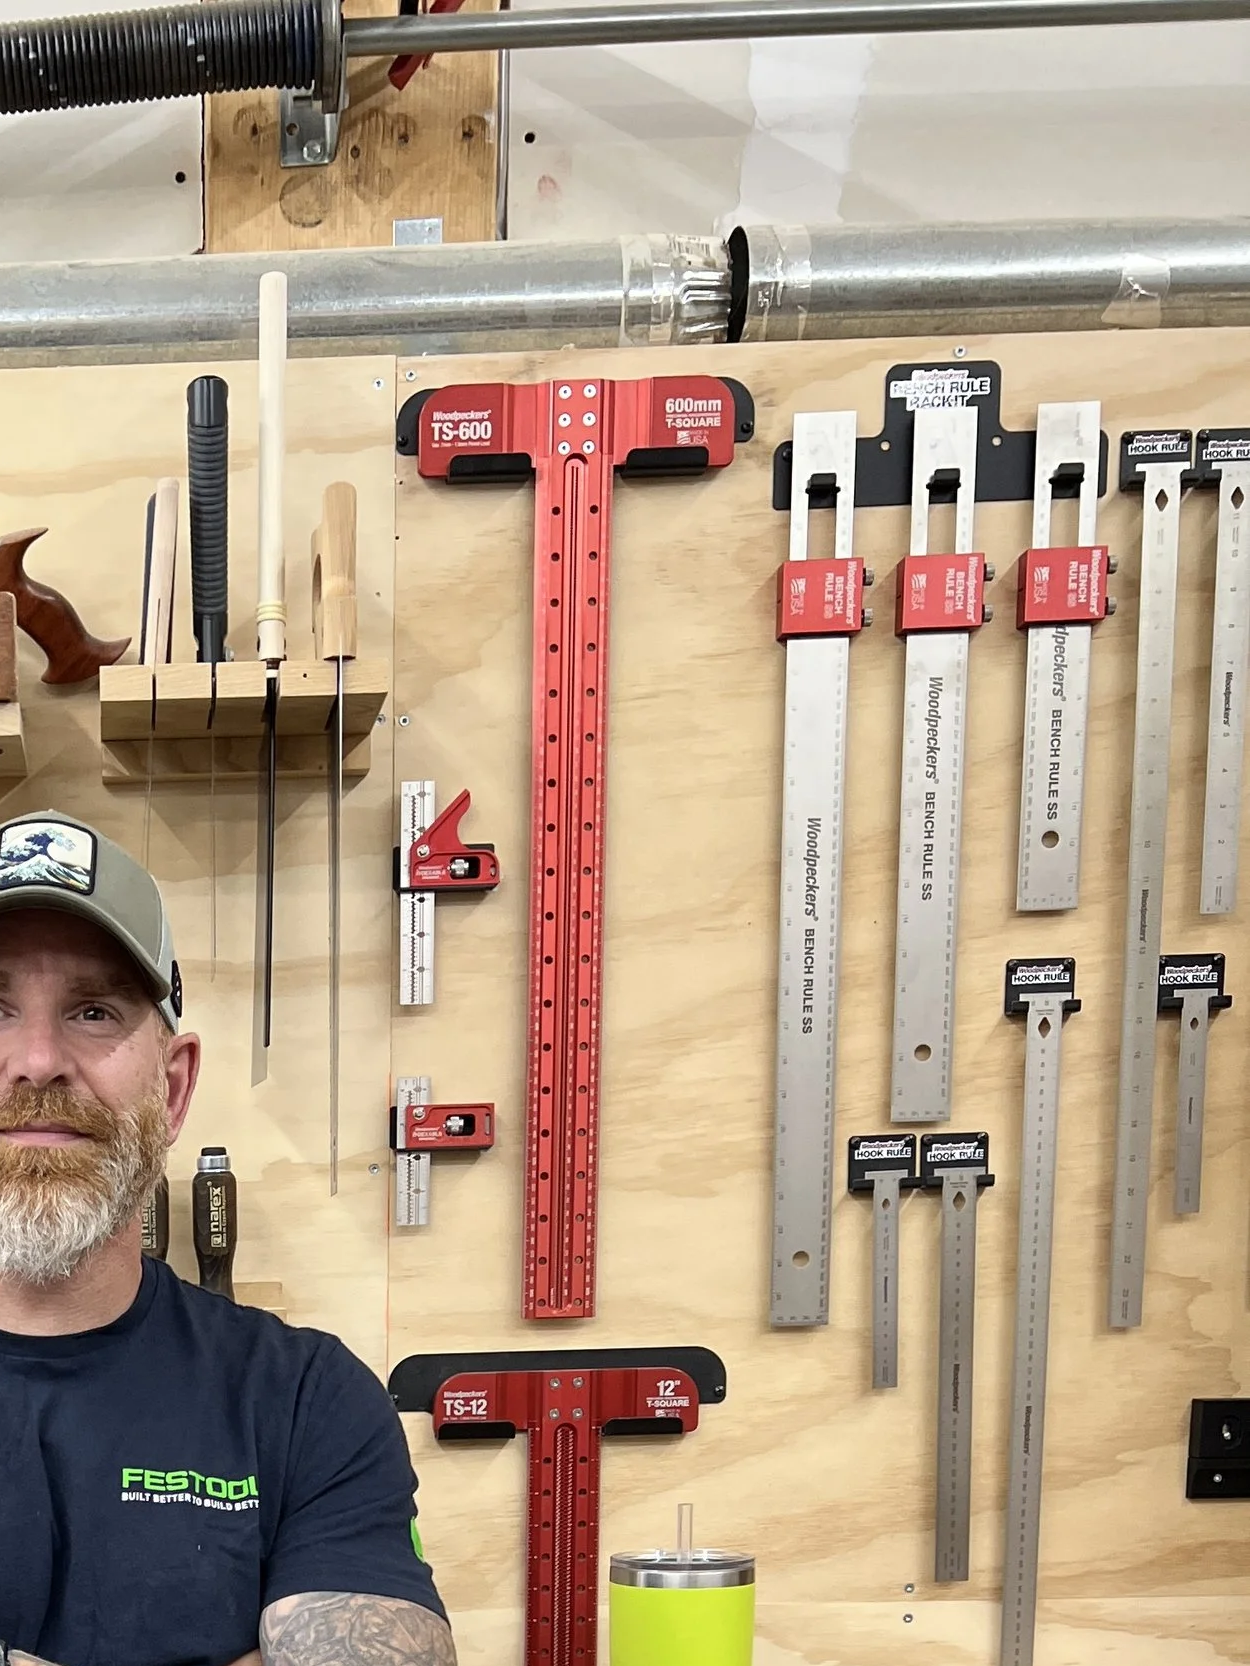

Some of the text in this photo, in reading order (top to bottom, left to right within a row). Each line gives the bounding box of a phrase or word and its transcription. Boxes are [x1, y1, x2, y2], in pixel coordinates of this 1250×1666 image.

[950, 381, 988, 393] RULE
[665, 397, 722, 413] 600mm
[431, 421, 492, 441] TS-600
[665, 417, 721, 428] T-SQUARE
[691, 436, 709, 444] USA
[1130, 443, 1186, 453] HOOK RULE
[1205, 450, 1232, 458] HOOK
[945, 568, 955, 600] RULE
[1069, 561, 1079, 592] RULE
[1078, 564, 1088, 604] BENCH
[824, 572, 834, 605] RULE
[835, 575, 844, 615] BENCH
[955, 571, 964, 610] BENCH
[1047, 709, 1062, 820] BENCH RULE SS
[924, 791, 936, 839] BENCH
[922, 843, 934, 879] RULE
[921, 883, 932, 901] SS
[803, 928, 815, 975] BENCH
[1012, 973, 1068, 982] HOOK RULE
[1162, 973, 1217, 983] HOOK RULE
[802, 978, 814, 1014] RULE
[802, 1017, 813, 1034] SS
[887, 1149, 911, 1157] RULE
[930, 1151, 983, 1160] HOOK RULE
[210, 1187, 221, 1232] narex
[657, 1380, 680, 1397] 12"
[443, 1400, 487, 1416] TS-12
[646, 1400, 690, 1408] T-SQUARE
[121, 1468, 258, 1501] FESTOOL
[121, 1491, 259, 1511] BUILT BETTER TO BUILD BETT
